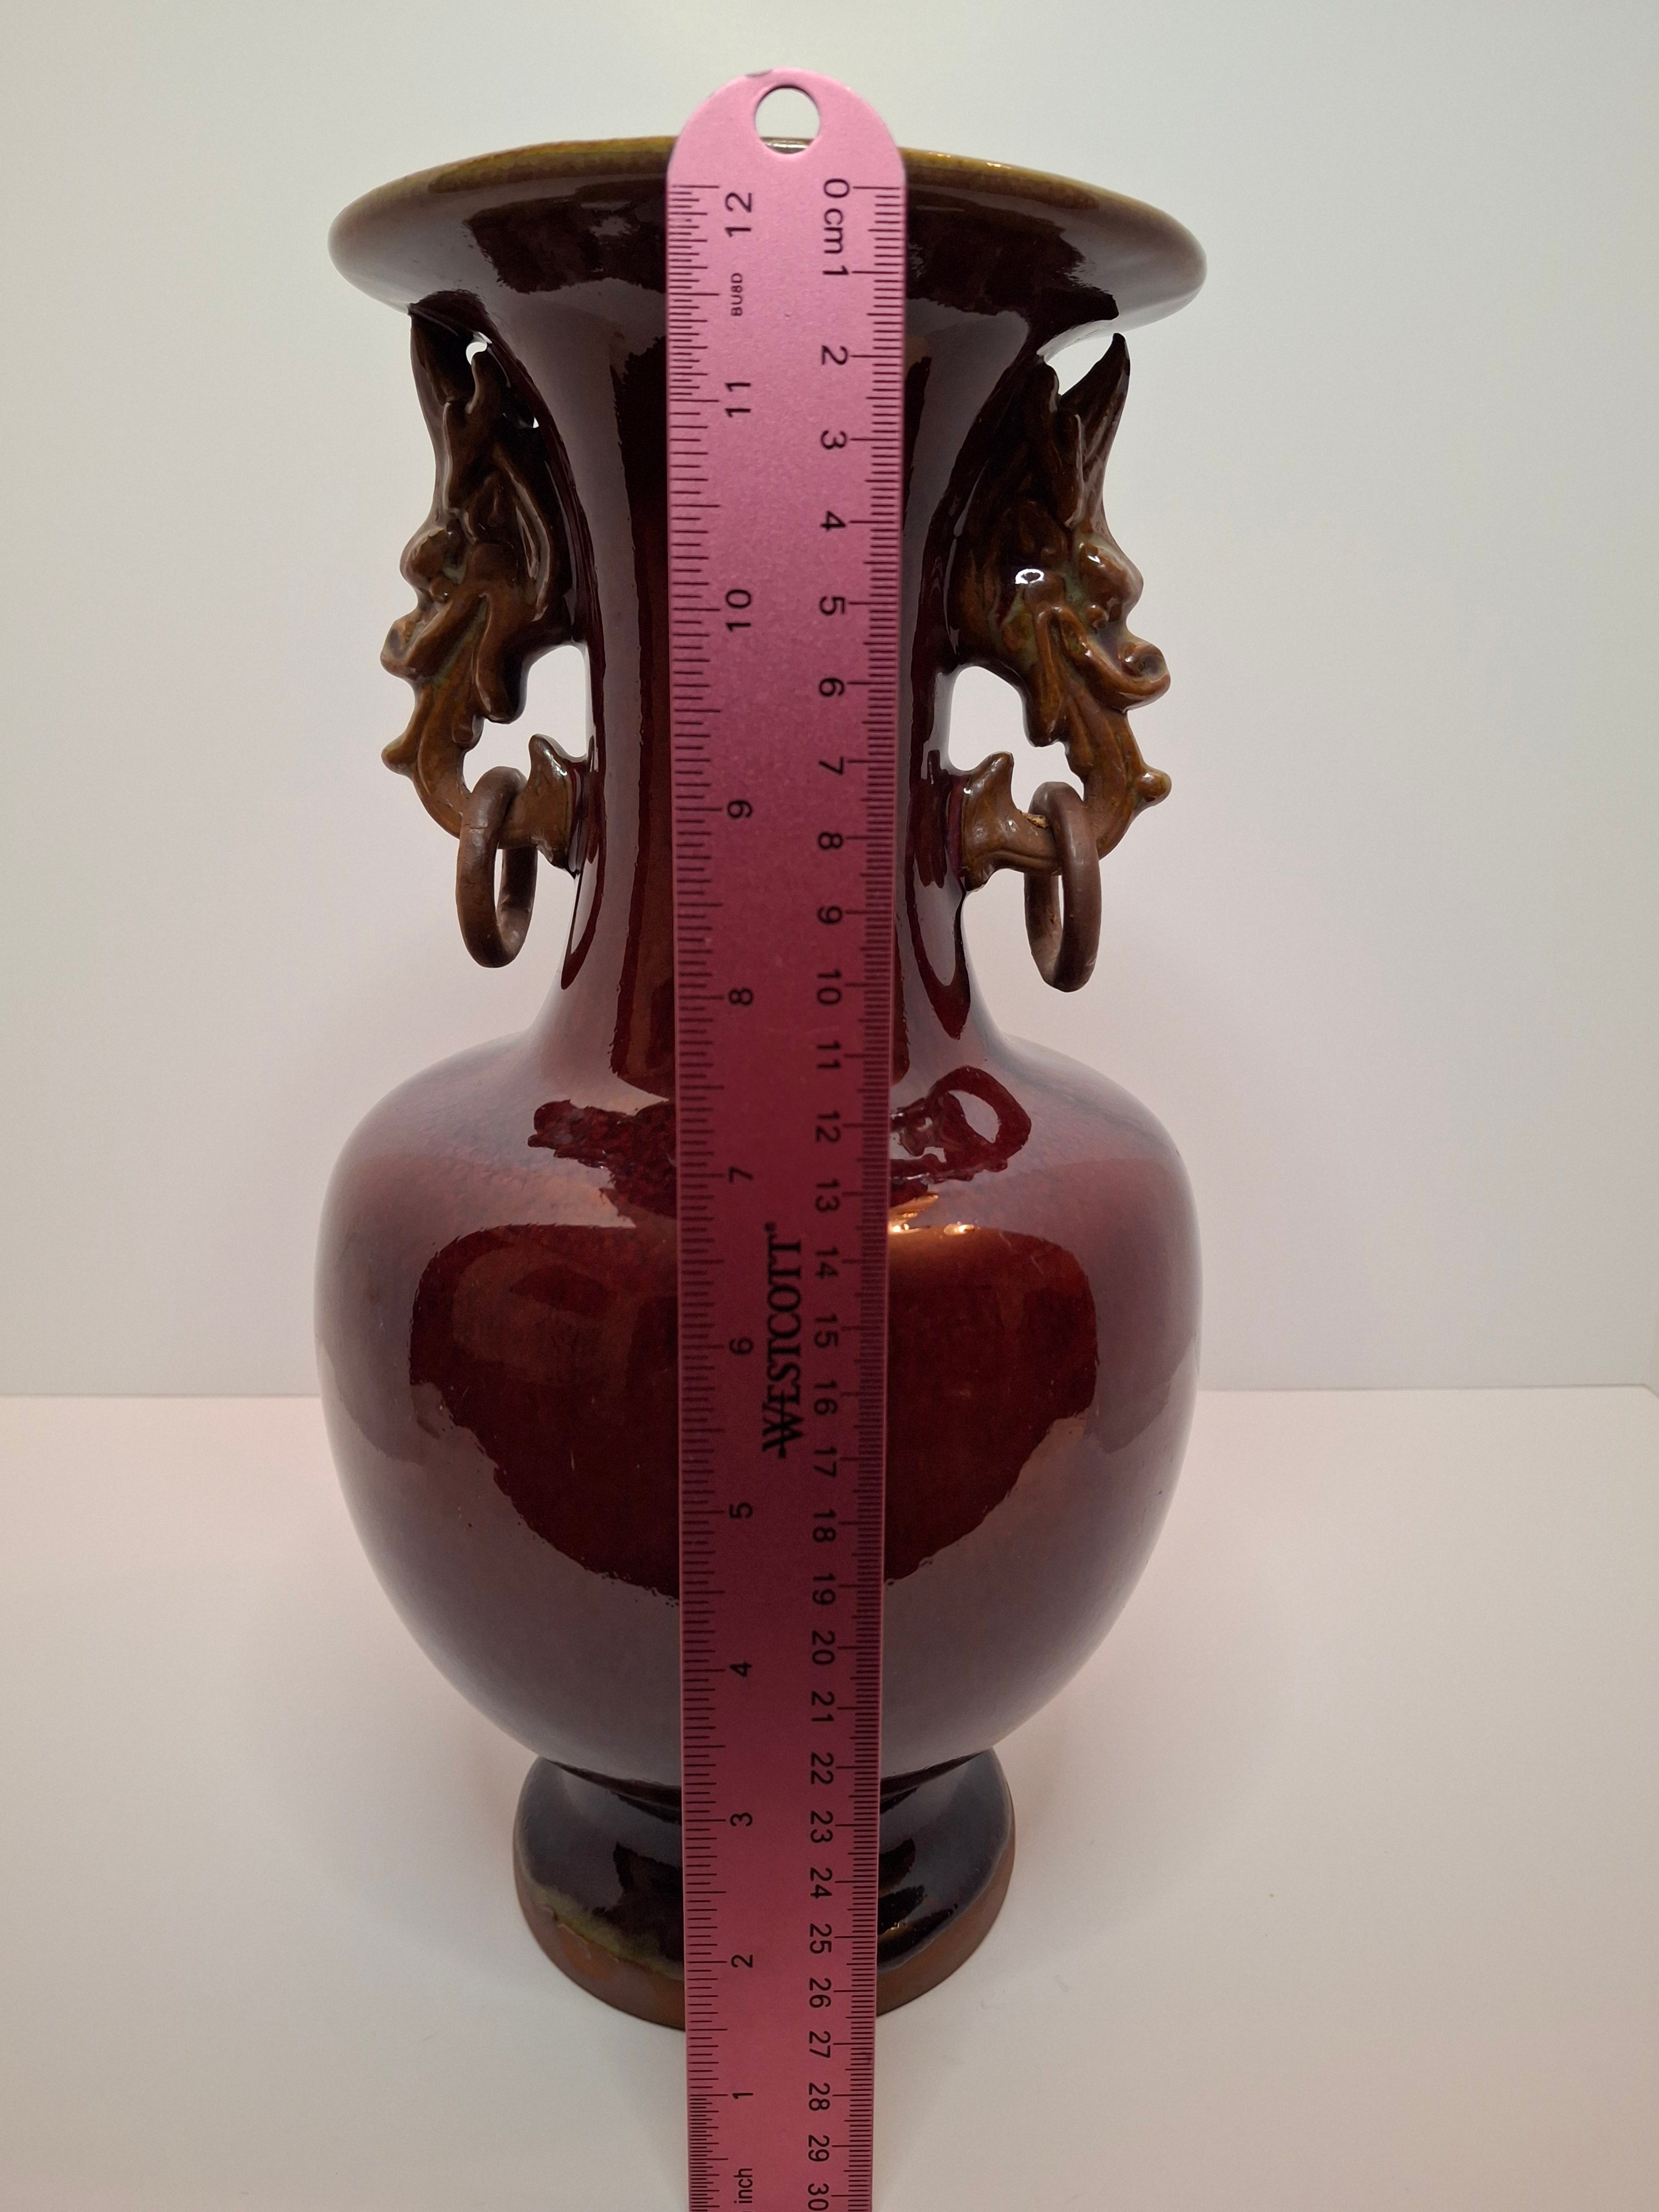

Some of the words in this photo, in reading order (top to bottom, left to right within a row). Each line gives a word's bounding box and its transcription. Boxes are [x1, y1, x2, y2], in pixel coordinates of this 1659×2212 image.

[824, 178, 850, 199] 0
[725, 192, 752, 237] 12
[824, 208, 844, 254] cm
[822, 266, 849, 275] 1
[821, 345, 848, 365] 2
[725, 382, 751, 417] 11
[820, 430, 847, 450] 3
[821, 511, 846, 531] 4
[725, 589, 752, 632] 10
[819, 596, 846, 616] 5
[819, 677, 845, 697] 6
[819, 757, 845, 776] 7
[727, 799, 753, 819] 9
[818, 831, 844, 851] 8
[817, 905, 843, 925] 9
[728, 987, 754, 1007] 8
[816, 969, 843, 1006] 10
[817, 1041, 841, 1069] 11
[815, 1111, 841, 1143] 12
[728, 1166, 753, 1183] 7
[815, 1179, 840, 1213] 13
[816, 1247, 839, 1279] 14
[813, 1314, 839, 1349] 15
[729, 1337, 754, 1356] 6
[813, 1380, 838, 1416] 16
[813, 1446, 837, 1478] 17
[728, 1502, 753, 1519] 5
[812, 1509, 837, 1543] 18
[812, 1573, 836, 1606] 19
[811, 1630, 835, 1666] 20
[729, 1662, 752, 1677] 4
[811, 1691, 835, 1722] 21
[811, 1752, 834, 1785] 22
[729, 1812, 753, 1827] 3
[810, 1810, 834, 1844] 23
[810, 1867, 833, 1899] 24
[809, 1923, 832, 1954] 25
[730, 1954, 754, 1969] 2
[809, 1977, 832, 2009] 26
[808, 2031, 831, 2059] 27
[808, 2082, 831, 2112] 28
[808, 2134, 830, 2162] 29
[734, 2168, 753, 2204] inch
[807, 2183, 829, 2211] 30
